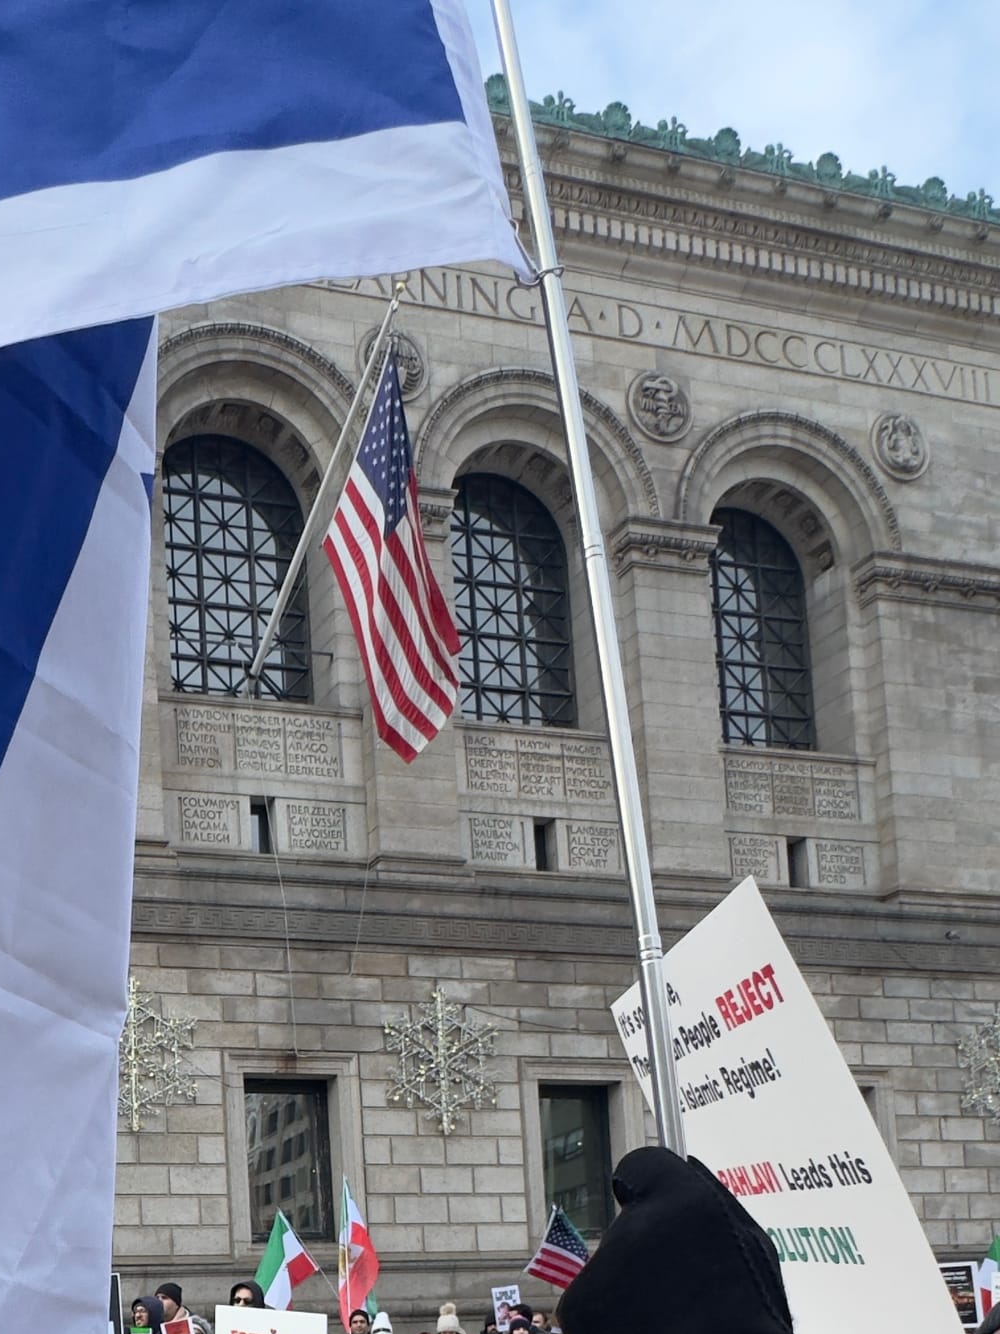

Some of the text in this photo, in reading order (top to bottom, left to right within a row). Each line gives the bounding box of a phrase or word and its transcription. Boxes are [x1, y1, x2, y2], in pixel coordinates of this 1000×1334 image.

[318, 267, 536, 321] RNING
[236, 714, 281, 726] HOOKER
[287, 718, 333, 731] AGASSIZ
[468, 735, 495, 746] BACH
[519, 739, 551, 750] HAYDN
[180, 743, 219, 755] DARWIN
[288, 742, 328, 753] ARAGO
[565, 744, 602, 755] WAGNER
[289, 753, 339, 766] BENTHAM
[288, 765, 339, 778] BERKELEY
[521, 774, 561, 785] MOZART
[817, 799, 851, 809] JONSON
[183, 809, 223, 819] CABOT
[817, 808, 857, 820] SHERIDAN
[473, 818, 513, 829] DALTON
[184, 832, 230, 843] RALEIGH
[571, 836, 615, 847] ALLSTON
[474, 839, 520, 851] SMEATON
[571, 847, 609, 858] COPLEY
[678, 1011, 721, 1054] People
[715, 963, 784, 1032] REJECT
[682, 1074, 724, 1110] Islamic
[719, 1048, 782, 1099] Regime!
[717, 1150, 873, 1197] PAHLAVI Leads this
[767, 1226, 865, 1265] OLUTION!
